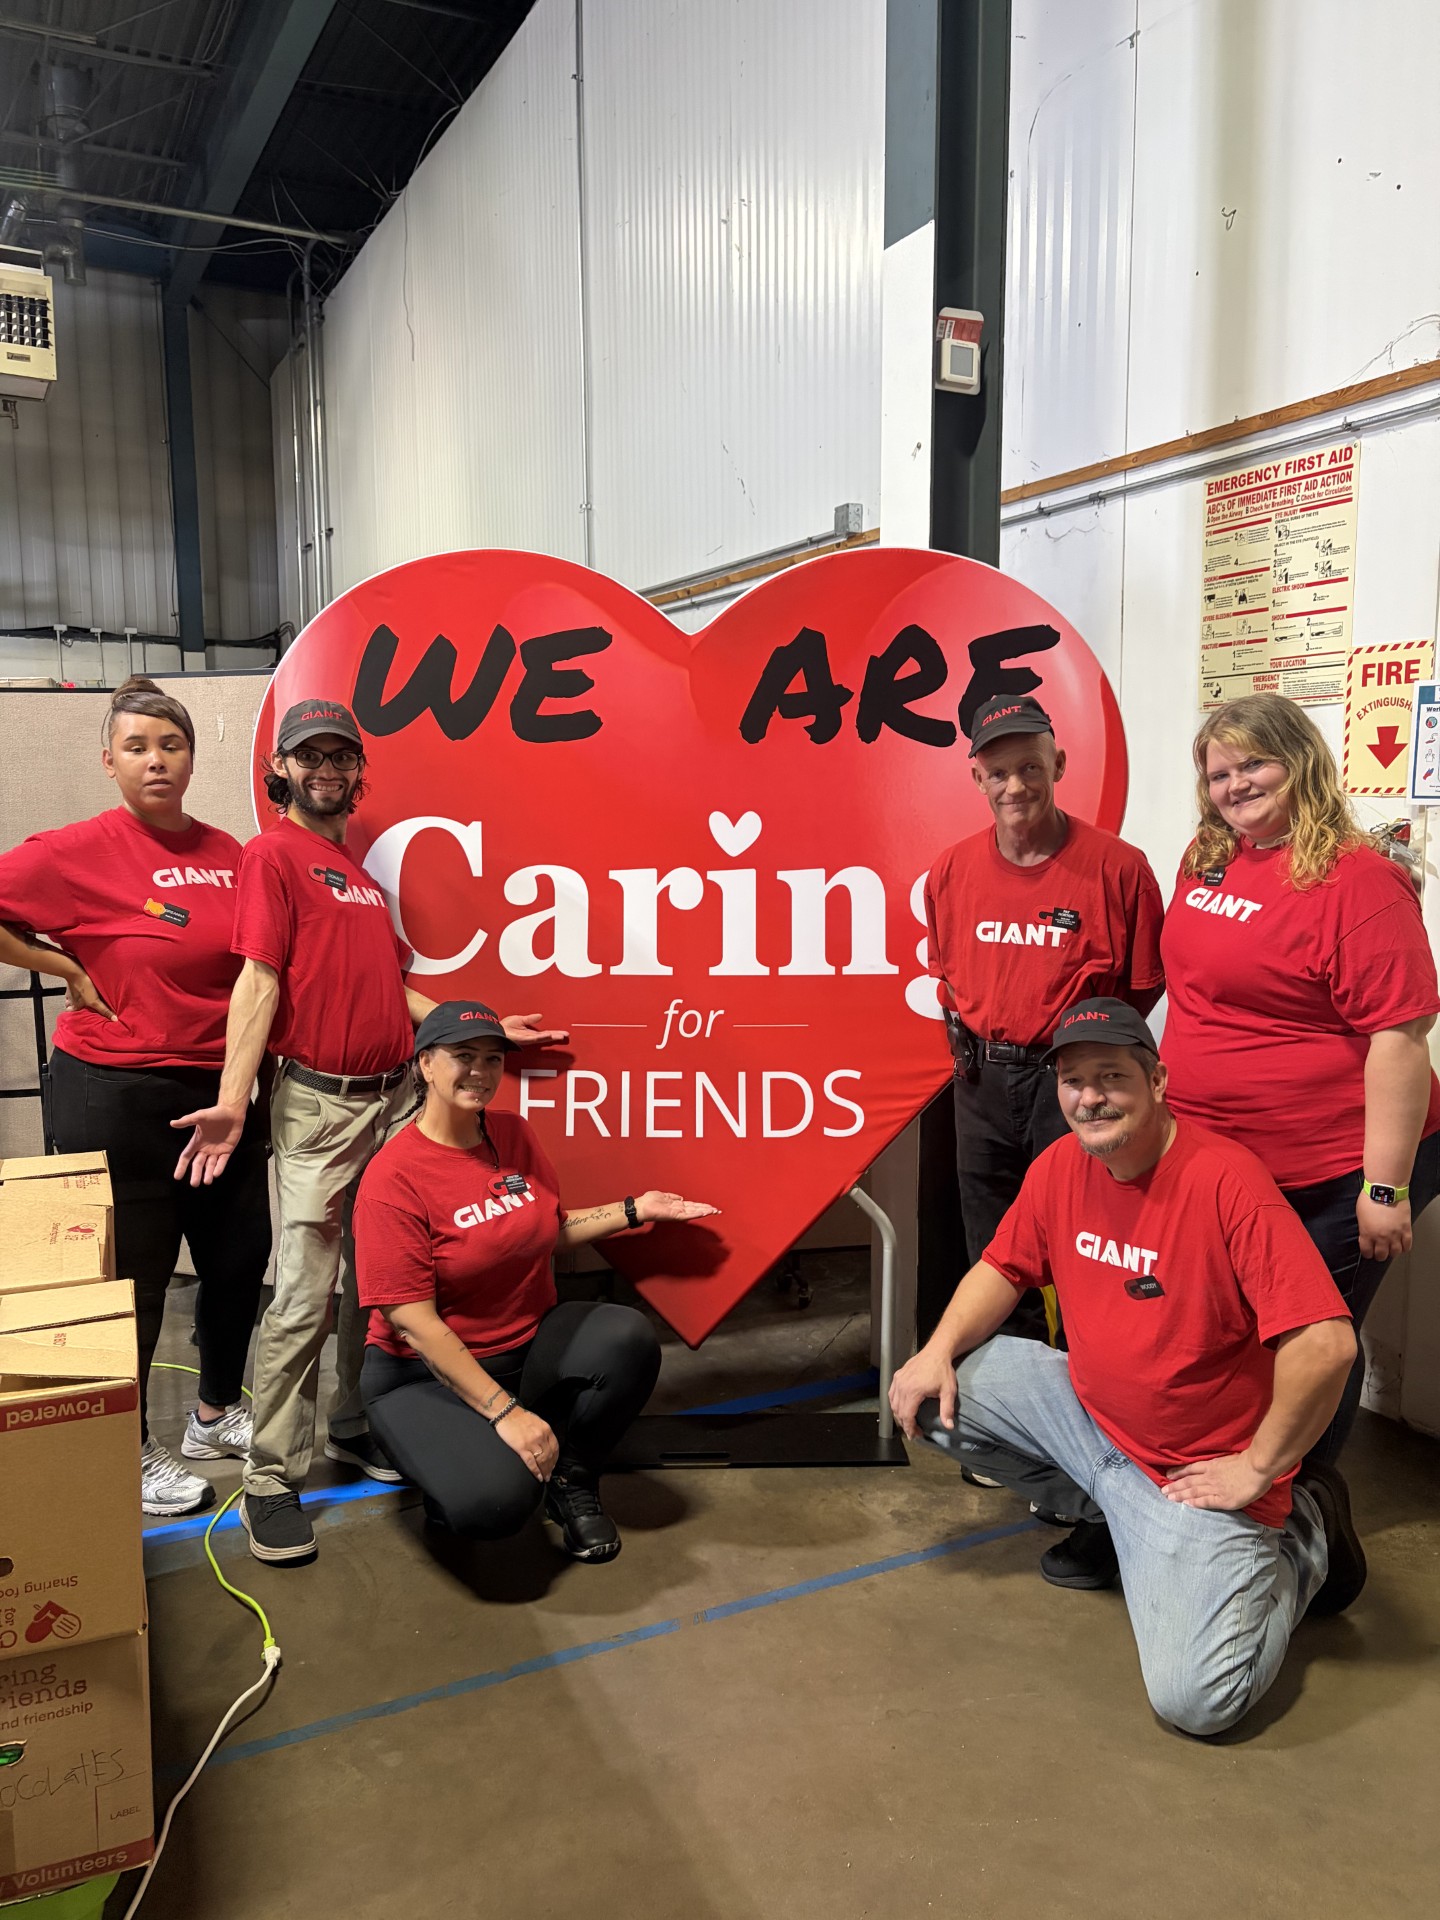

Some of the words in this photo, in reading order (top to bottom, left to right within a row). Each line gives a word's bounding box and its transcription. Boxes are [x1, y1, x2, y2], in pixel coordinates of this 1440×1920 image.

[1207, 464, 1281, 496] EMERGENCY
[1285, 453, 1325, 476] FIRST
[1328, 446, 1353, 466] AID
[1227, 498, 1236, 511] OF
[1238, 488, 1278, 508] IMMEDIATE
[1280, 482, 1302, 499] FIRST
[1304, 478, 1319, 492] AID
[1320, 470, 1352, 489] ACTION
[1325, 485, 1352, 497] Circulation
[1282, 658, 1307, 668] LOCATION
[1361, 659, 1421, 687] FIRE
[352, 624, 613, 743] WE
[739, 624, 1061, 747] ARE
[1252, 673, 1280, 683] EMERGENCY
[1253, 682, 1279, 692] TELEPHONE
[301, 709, 342, 721] GIANT
[1356, 696, 1413, 721] EXTINGUISH
[153, 866, 234, 888] GIANT
[332, 884, 385, 908] GIANT
[1185, 887, 1264, 923] GIANT
[976, 920, 1068, 947] GIANT
[656, 999, 724, 1050] for
[1063, 1010, 1110, 1029] GIANT
[519, 1068, 866, 1138] FRIENDS
[1075, 1230, 1159, 1277] GIANT
[6, 1397, 105, 1430] Powered
[24, 1575, 79, 1594] Sharing
[23, 1701, 94, 1726] friendship
[110, 1805, 142, 1821] LABEL
[13, 1851, 129, 1889] Volunteers
